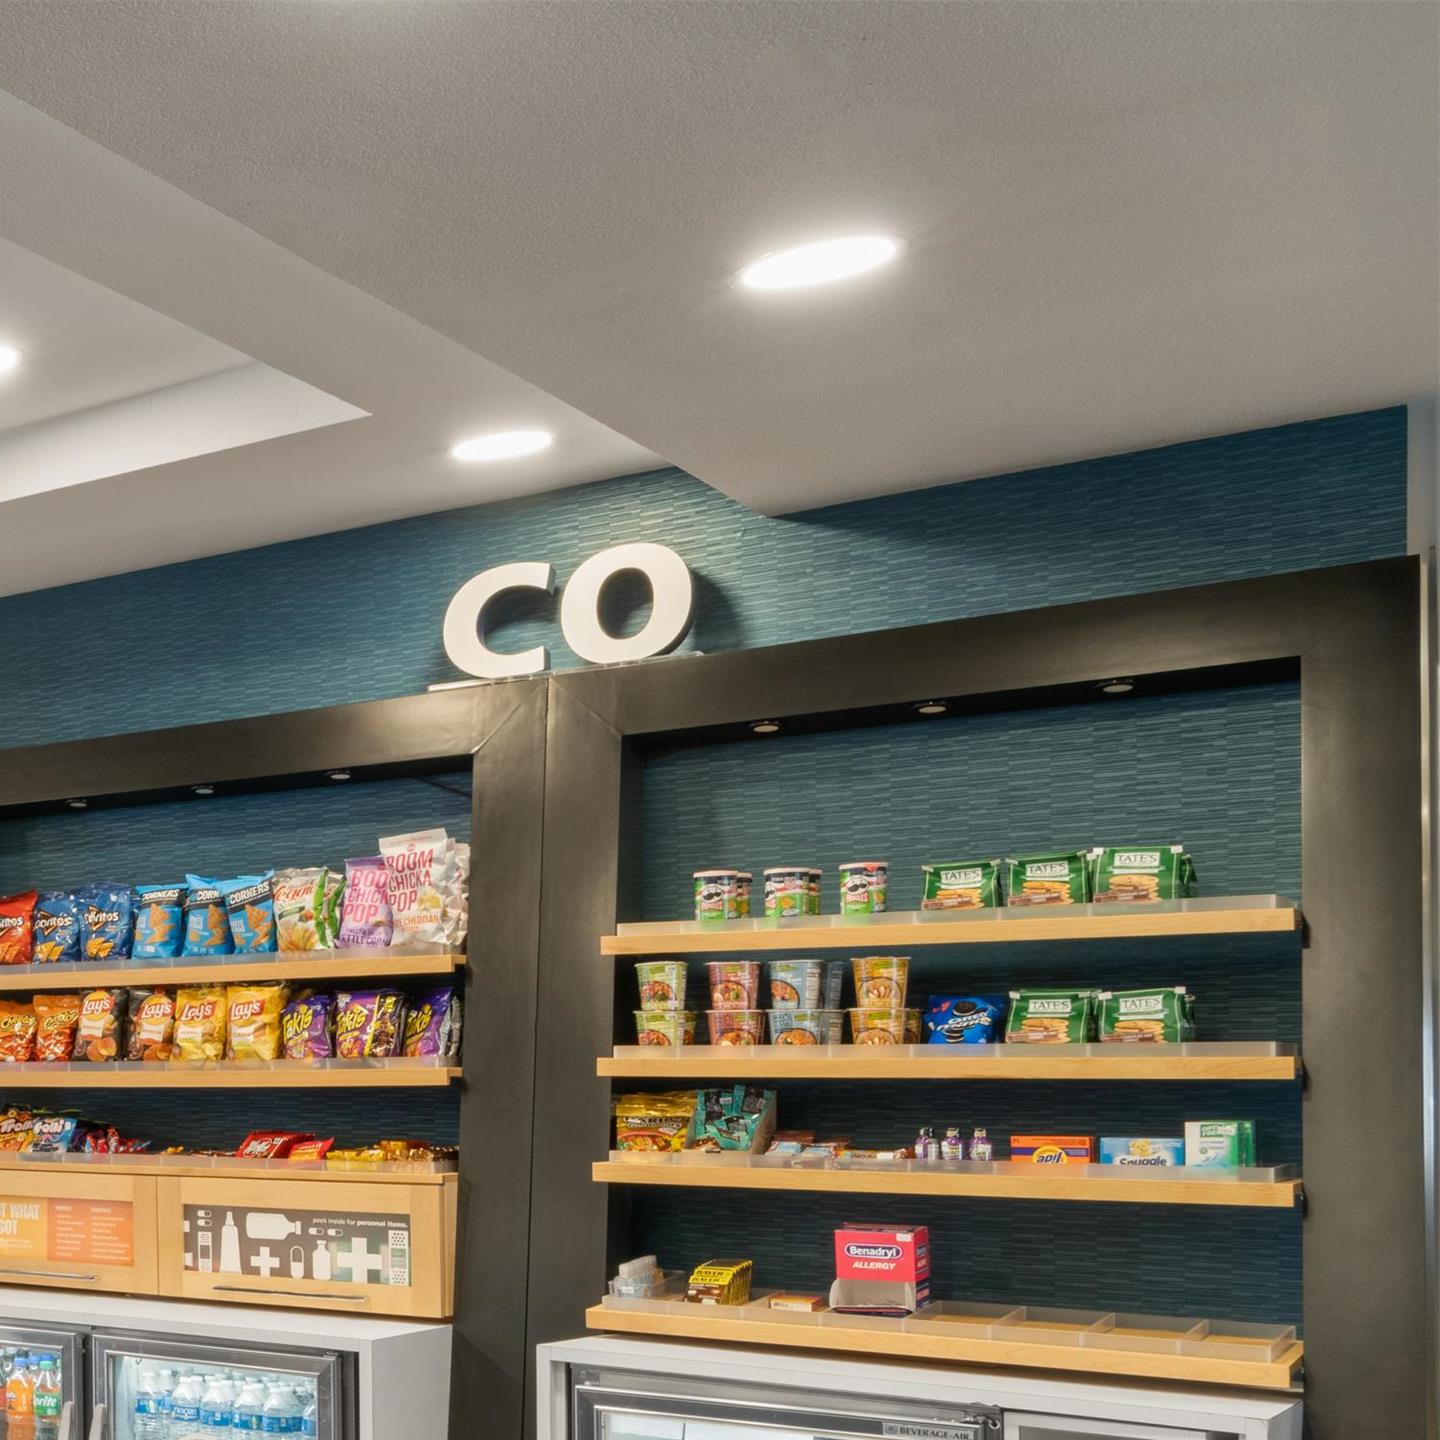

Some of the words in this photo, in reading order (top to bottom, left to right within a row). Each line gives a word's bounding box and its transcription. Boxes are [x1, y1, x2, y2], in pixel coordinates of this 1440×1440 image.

[386, 849, 434, 875] BOOM
[1118, 853, 1158, 864] TATE'S
[943, 868, 981, 881] TATE'S
[1028, 862, 1067, 876] TATE'S
[351, 868, 391, 889] BOO
[389, 869, 433, 893] CHICKA
[10, 1204, 41, 1221] WHAT
[346, 1218, 356, 1226] for
[356, 1219, 386, 1228] personal
[849, 1245, 897, 1259] Benadryl
[852, 1261, 896, 1270] ALLERGY
